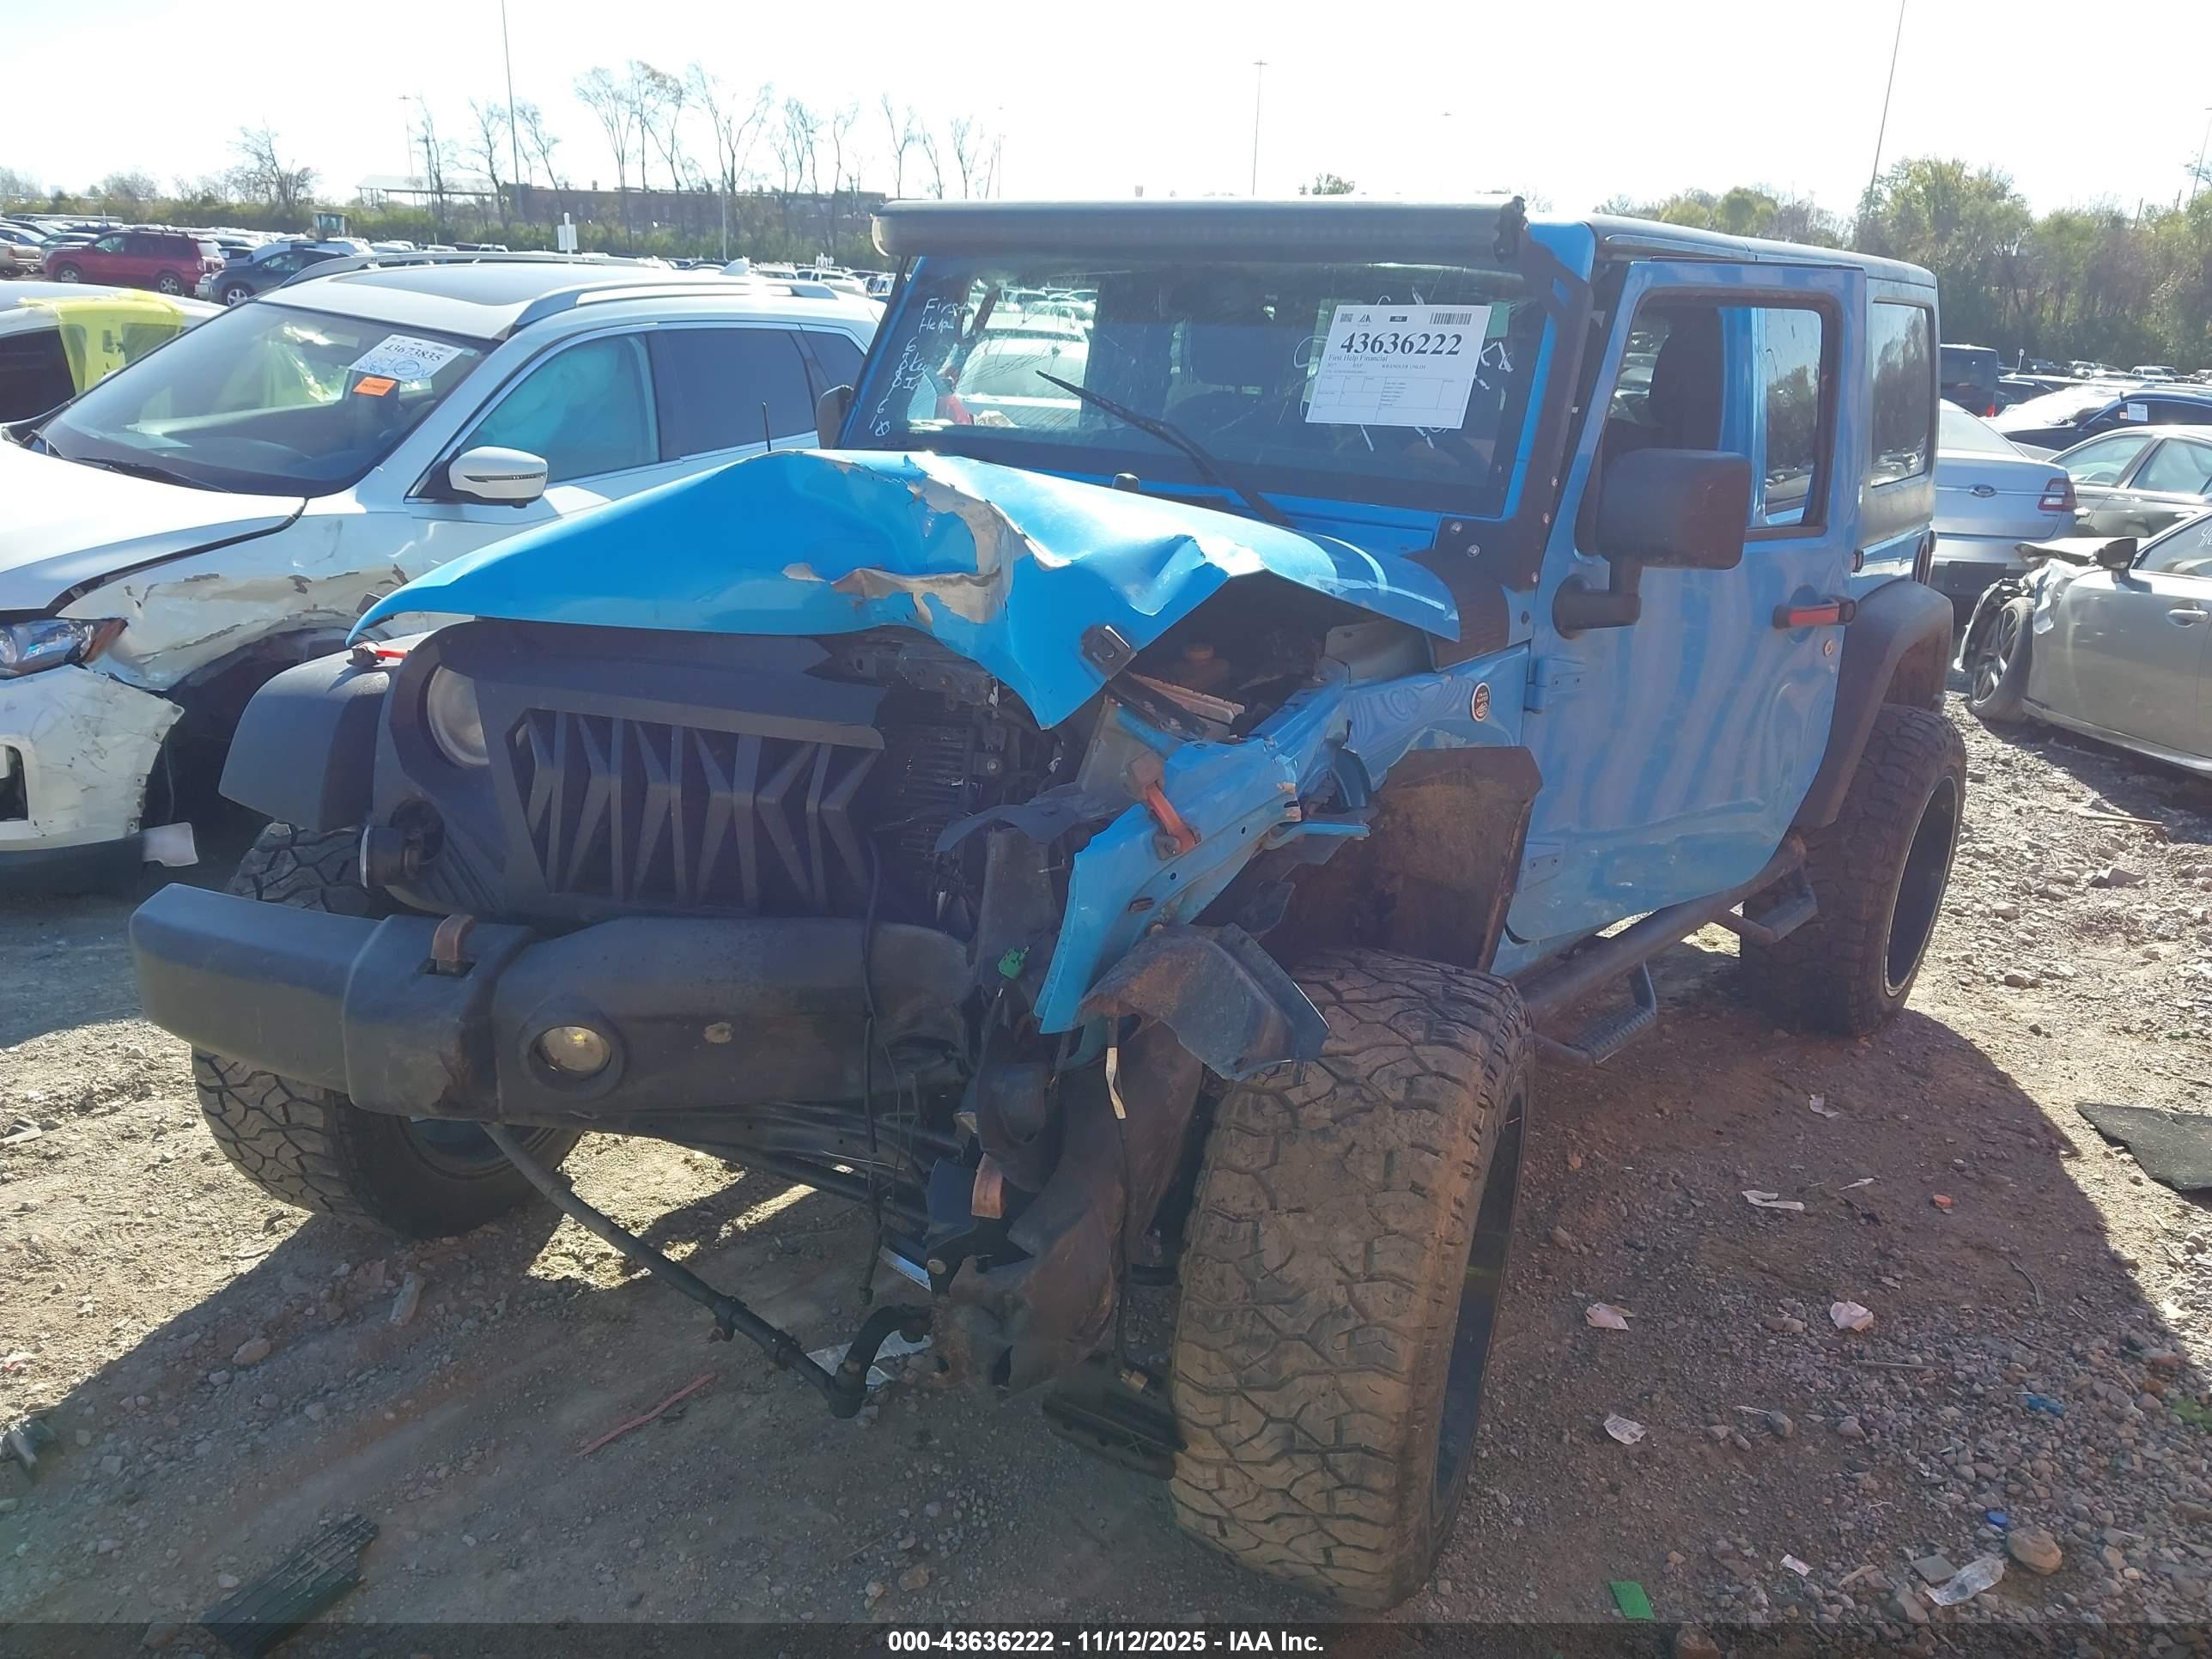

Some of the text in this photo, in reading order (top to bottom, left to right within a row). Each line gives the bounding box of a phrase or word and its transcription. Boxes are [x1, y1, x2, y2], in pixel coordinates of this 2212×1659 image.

[922, 296, 969, 317] First
[919, 317, 955, 334] Help
[1340, 331, 1463, 356] 43636222
